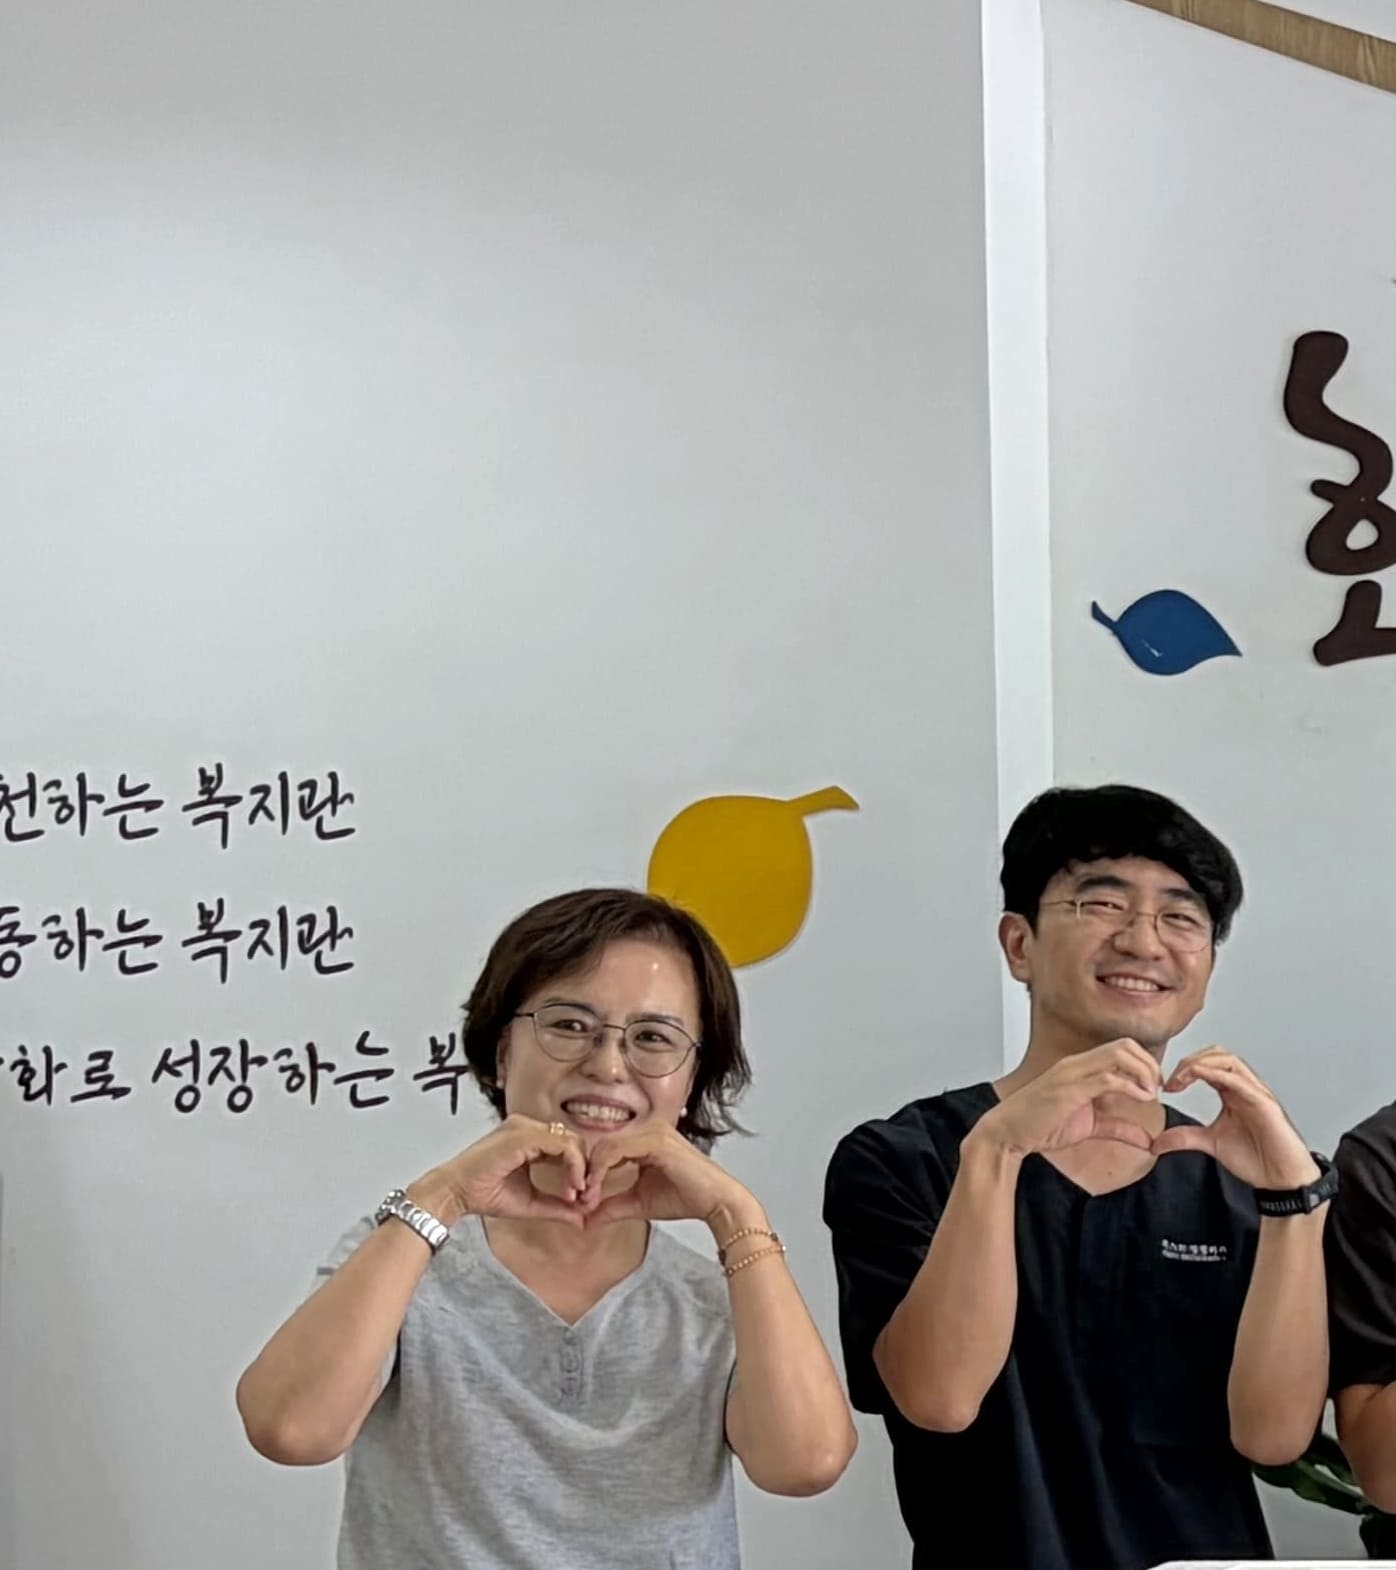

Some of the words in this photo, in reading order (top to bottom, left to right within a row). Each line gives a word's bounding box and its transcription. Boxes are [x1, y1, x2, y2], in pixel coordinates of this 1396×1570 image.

[181, 762, 357, 850] 복지관
[181, 897, 356, 984] 복지관
[152, 1031, 396, 1115] 성장하는
